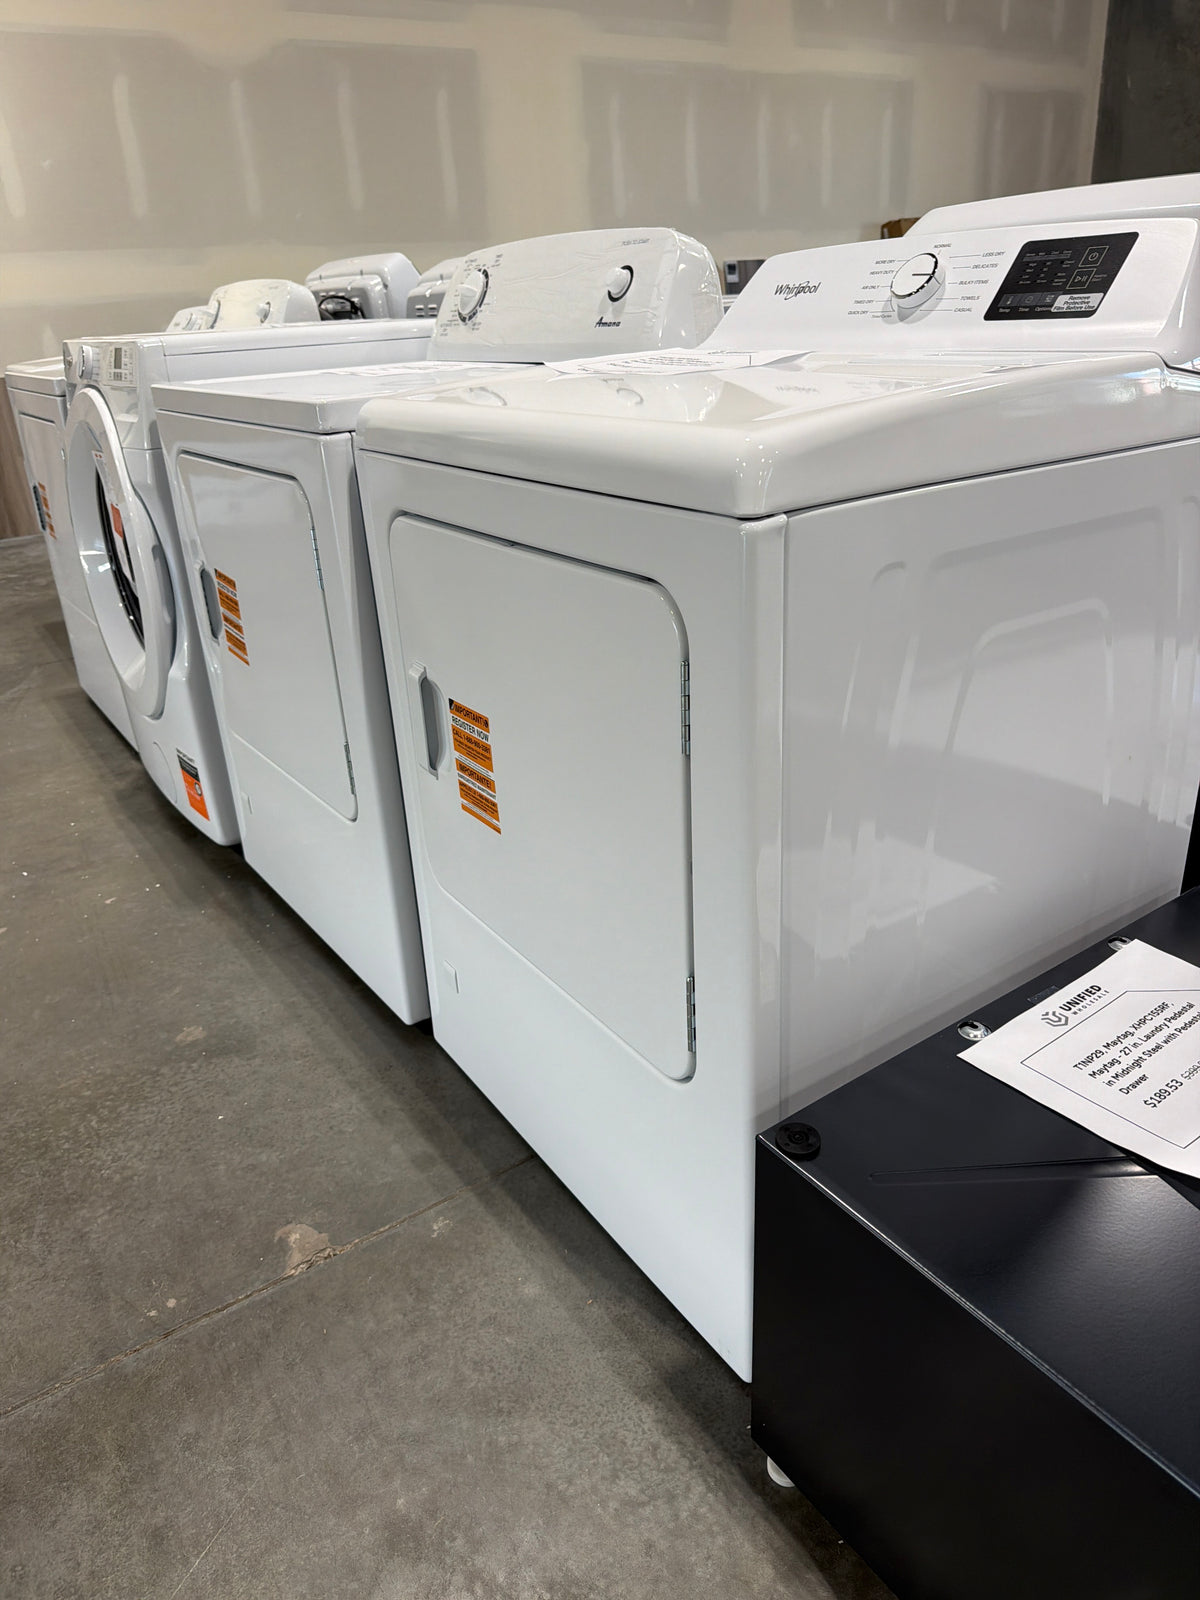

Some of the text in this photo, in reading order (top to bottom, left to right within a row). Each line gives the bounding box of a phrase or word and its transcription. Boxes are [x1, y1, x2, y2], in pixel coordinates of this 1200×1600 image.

[774, 280, 822, 300] Whirlpool
[594, 316, 621, 328] Amana
[452, 716, 489, 742] REGISTER NOW
[1058, 984, 1102, 1012] UNIFIED
[1071, 990, 1110, 1015] WHOLESALE
[1072, 1050, 1108, 1070] T1NP29,
[1102, 1030, 1135, 1050] Maytag,
[1088, 1057, 1120, 1079] Maytag
[1120, 1046, 1132, 1056] 27
[1138, 1022, 1170, 1043] Laundry
[1164, 1002, 1196, 1024] Pedestal
[1111, 1056, 1148, 1081] Midnight
[1142, 1042, 1164, 1058] Steel
[1160, 1032, 1180, 1044] with
[1118, 1074, 1149, 1095] Drawer
[1143, 1079, 1184, 1108] $189.53
